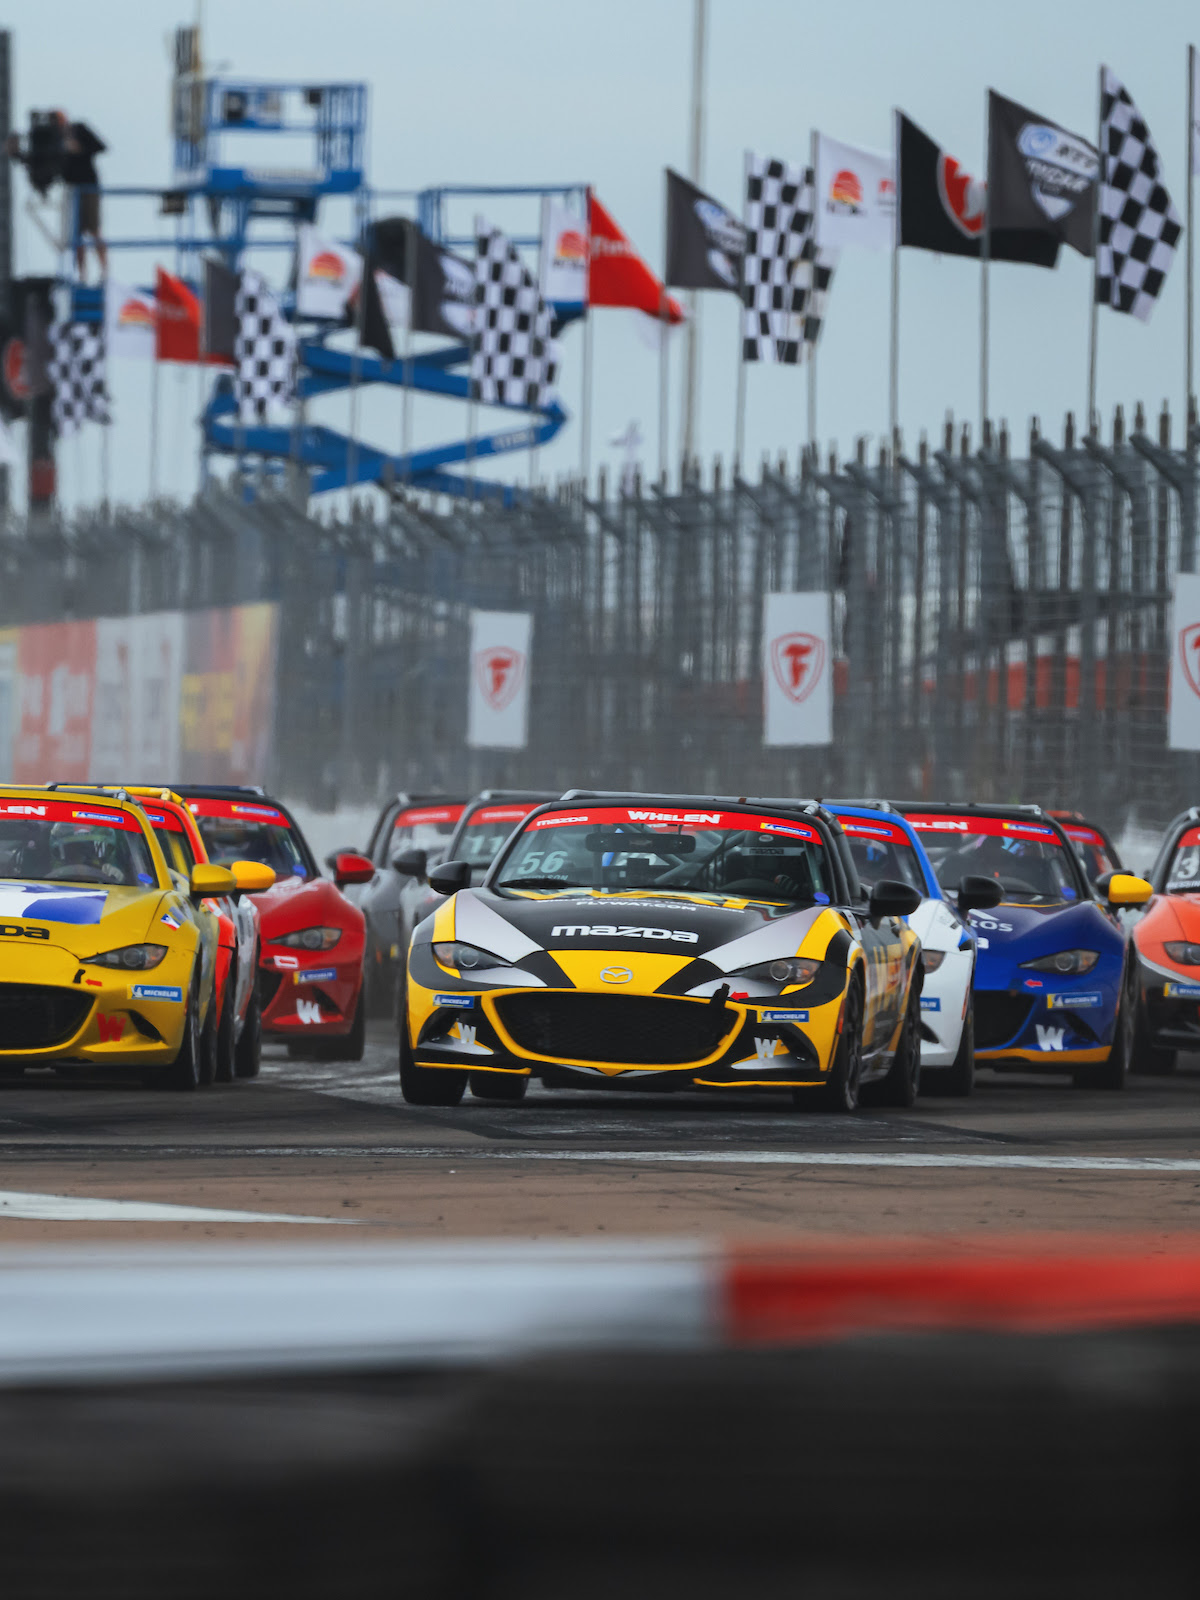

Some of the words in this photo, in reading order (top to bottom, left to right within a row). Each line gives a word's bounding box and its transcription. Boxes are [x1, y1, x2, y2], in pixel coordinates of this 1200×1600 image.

[536, 816, 589, 826] mazda
[627, 810, 720, 824] WHELEN
[911, 820, 968, 831] ELEN
[517, 850, 569, 875] 56
[551, 925, 699, 943] mazda
[142, 989, 179, 999] MICHELIN
[772, 1011, 806, 1021] MICHELIN
[96, 1013, 127, 1043] W
[458, 1022, 477, 1045] W
[1035, 1024, 1065, 1051] W
[754, 1037, 779, 1059] W
